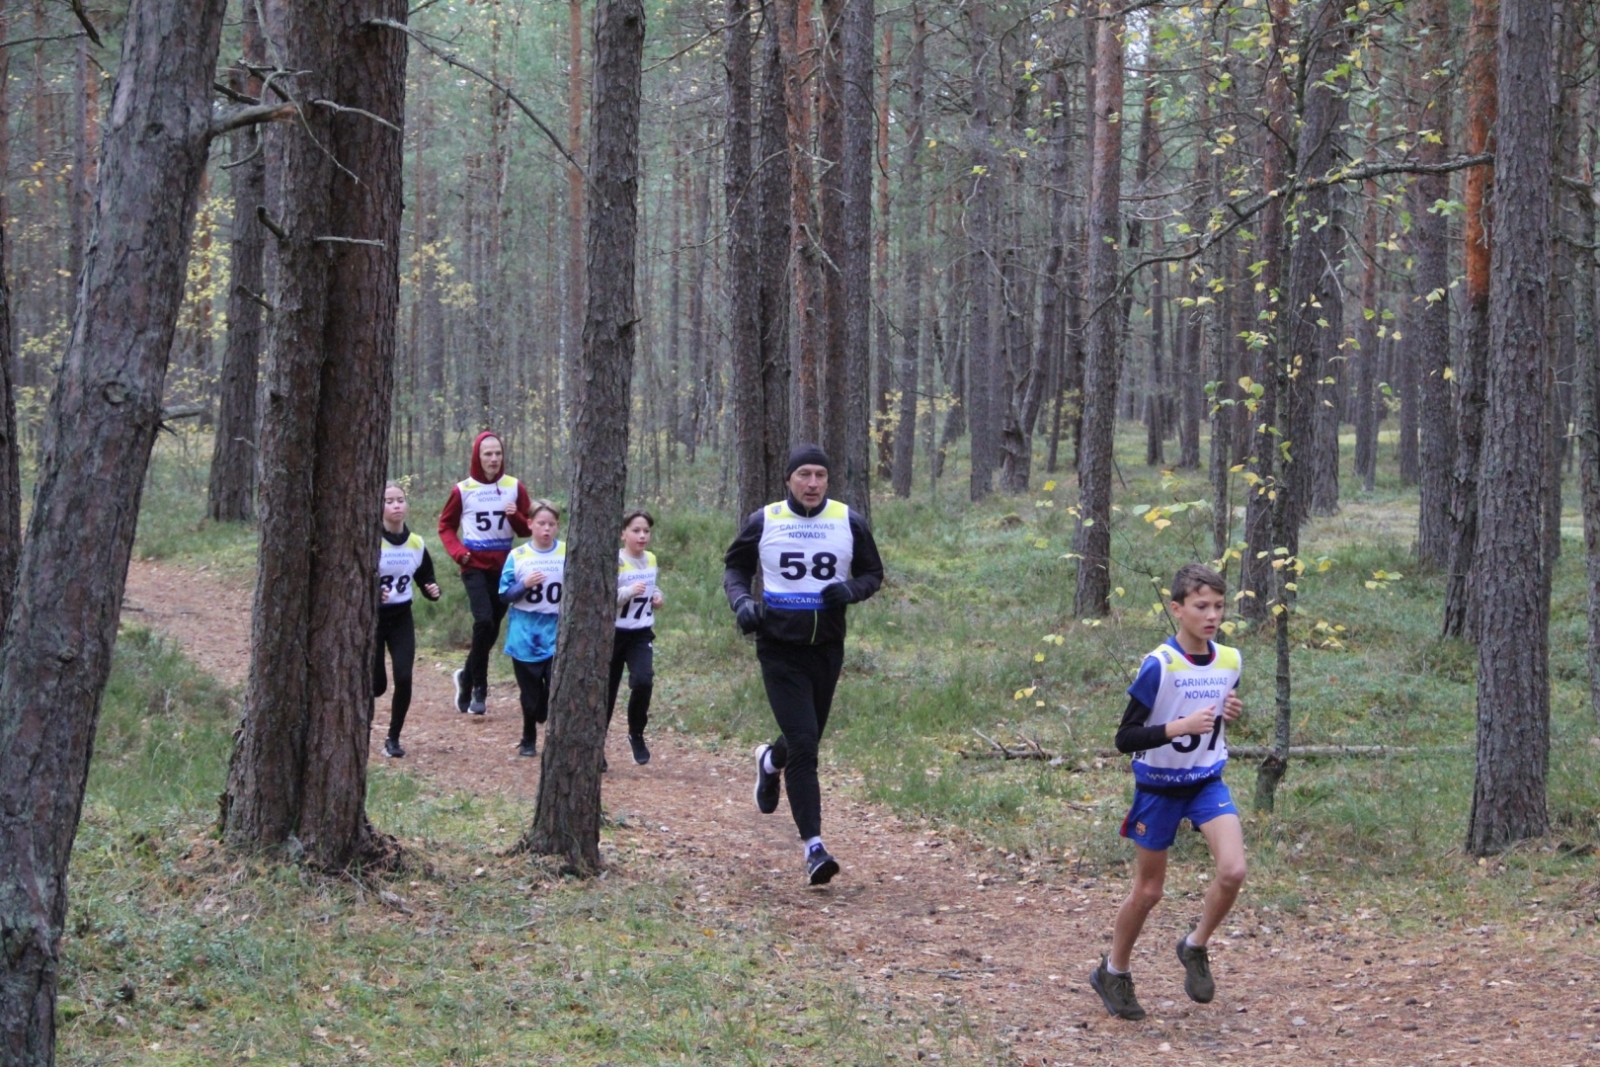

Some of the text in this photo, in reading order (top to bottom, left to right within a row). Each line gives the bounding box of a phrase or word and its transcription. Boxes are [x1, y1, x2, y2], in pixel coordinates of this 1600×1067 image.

[472, 489, 507, 498] CARNIKAS
[475, 510, 506, 532] 57
[780, 523, 835, 532] CARNIKAVAS
[788, 531, 827, 539] NOVADS
[779, 551, 838, 581] 58
[526, 581, 562, 605] 80
[1174, 677, 1227, 688] CARNIKAVAS
[1184, 689, 1221, 700] NOVADS
